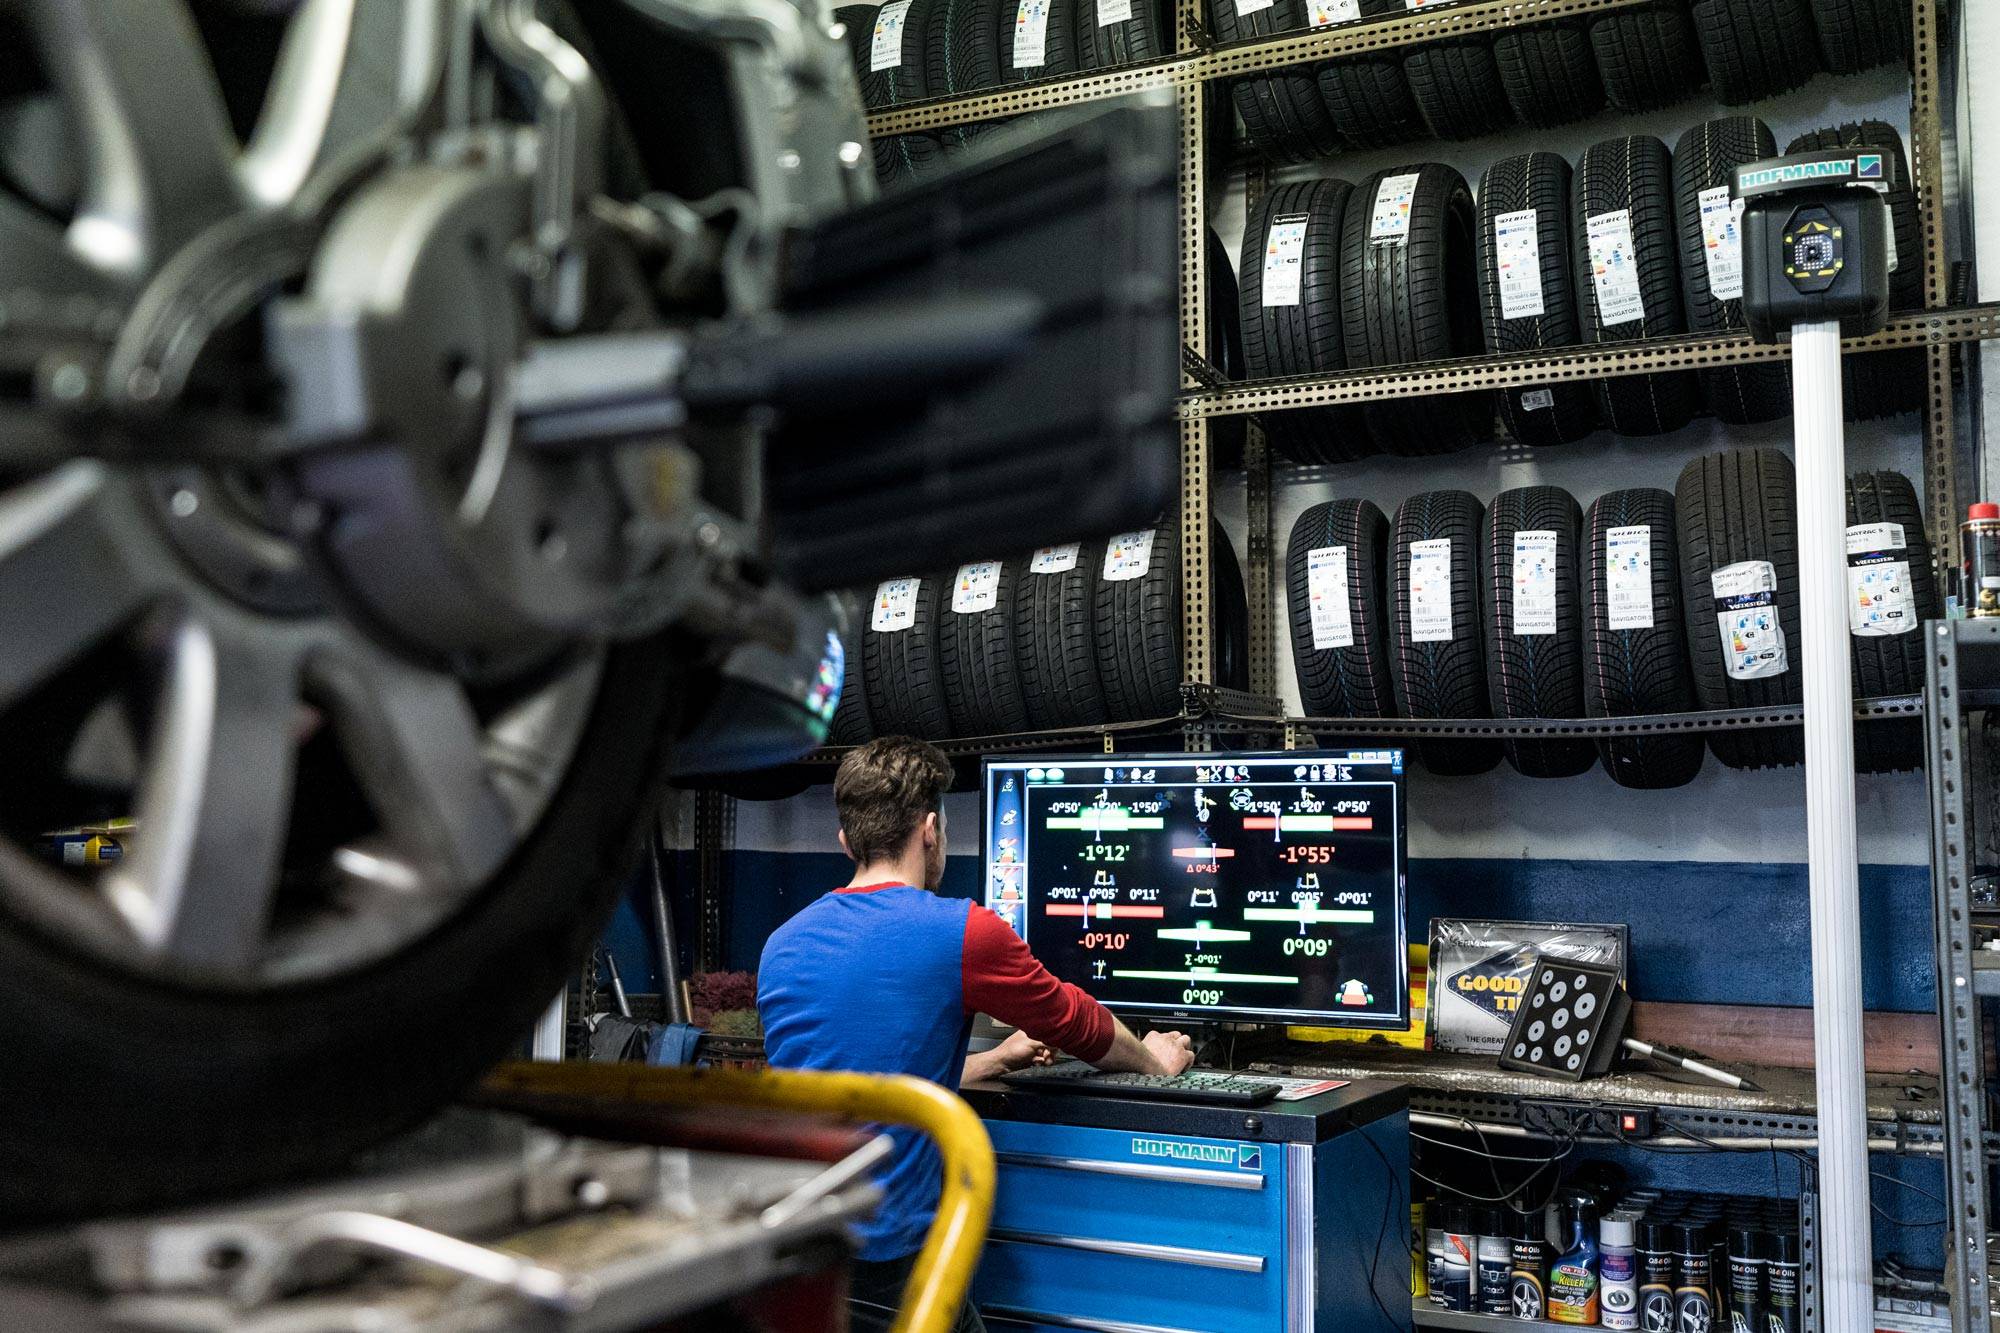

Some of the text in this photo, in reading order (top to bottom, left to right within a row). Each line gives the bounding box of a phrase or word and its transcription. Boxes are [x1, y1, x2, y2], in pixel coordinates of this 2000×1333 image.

[1739, 160, 1852, 190] HOFMANN
[1504, 303, 1537, 313] NAVIGATOR
[1603, 308, 1637, 319] NAVIGATOR
[1315, 634, 1347, 643] NAVIGATOR
[1078, 845, 1130, 861] -1°12'
[1279, 846, 1335, 863] -1°55'
[1078, 933, 1130, 950] -0°10'
[1283, 938, 1332, 956] 0°09'
[1183, 989, 1224, 1005] 0°09'
[1493, 995, 1523, 1011] TI
[1466, 1035, 1508, 1044] THE GREAT
[1132, 1138, 1234, 1163] HOFMANN
[1559, 1275, 1585, 1287] KILLER
